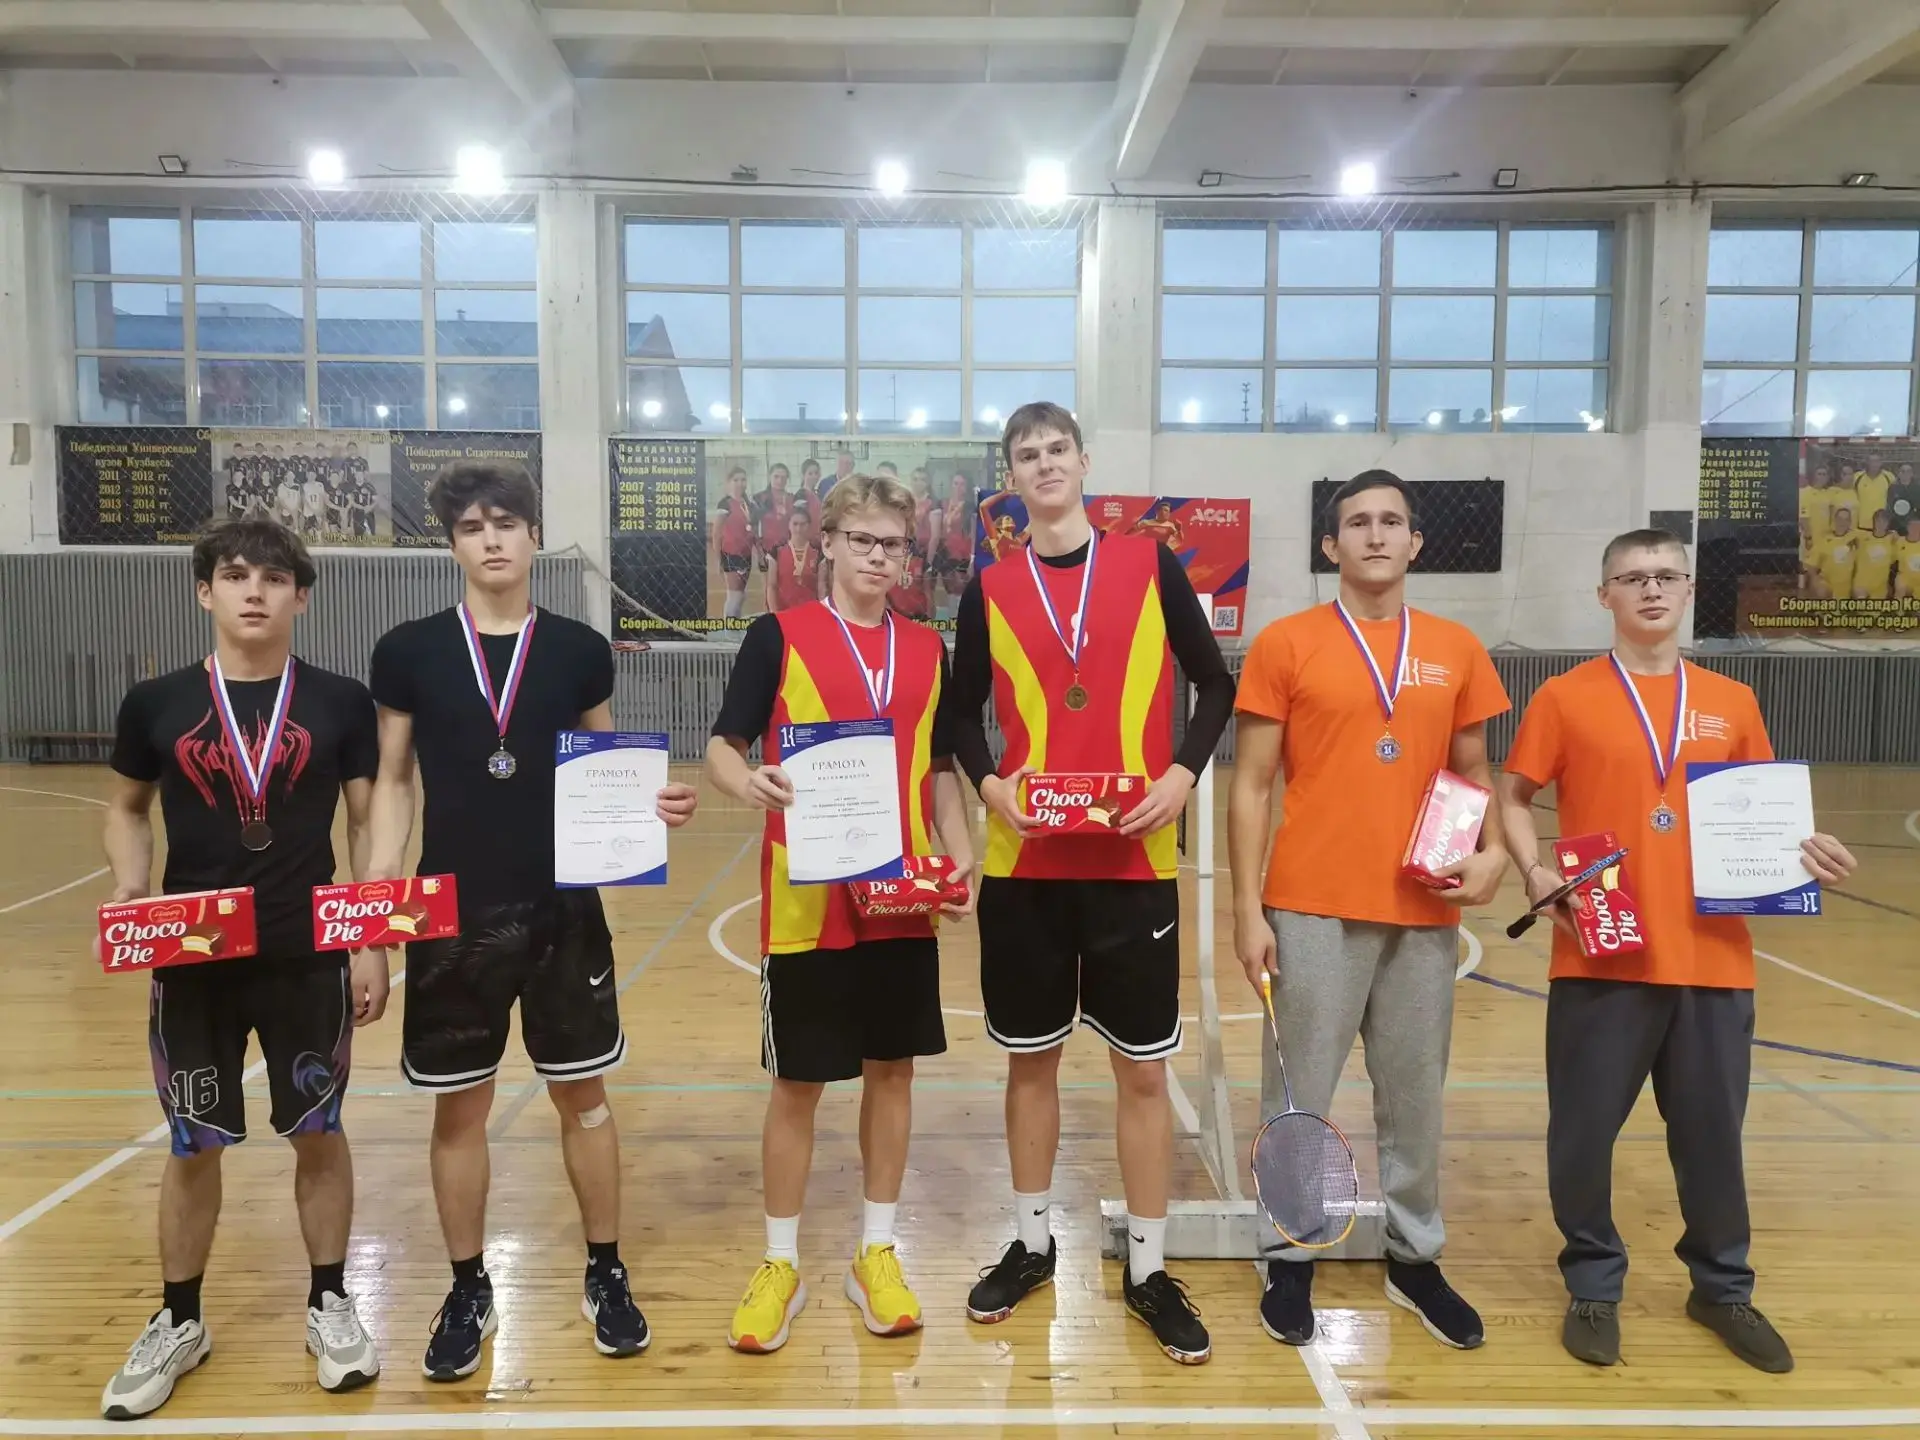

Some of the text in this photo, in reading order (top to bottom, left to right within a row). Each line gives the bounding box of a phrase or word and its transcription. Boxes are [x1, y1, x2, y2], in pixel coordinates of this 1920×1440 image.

[70, 442, 128, 454] Победители
[405, 446, 462, 457] Победители
[620, 482, 645, 492] 2007
[655, 482, 681, 492] 2008
[1699, 480, 1720, 488] 2010
[1729, 480, 1749, 488] 2011
[620, 495, 645, 505] 2008
[655, 495, 681, 505] 2009
[1699, 490, 1719, 499] 2011
[1728, 490, 1750, 499] 2012
[100, 499, 122, 509] 2013
[133, 499, 155, 509] 2014
[1698, 500, 1720, 509] 2012
[1728, 500, 1749, 509] 2013
[100, 513, 122, 523] 2014
[134, 513, 156, 523] 2015
[620, 508, 645, 518] 2009
[655, 508, 681, 518] 2010
[1189, 508, 1240, 523] АССК
[1698, 510, 1720, 519] 2013
[1729, 510, 1751, 519] 2014
[620, 520, 645, 530] 2013
[655, 520, 681, 530] 2014
[1779, 597, 1838, 613] Сборная
[1840, 599, 1900, 612] команда
[620, 617, 669, 631] Сборная
[672, 619, 724, 631] команда
[1749, 613, 1919, 630] Чемпионы Сибири среди
[811, 759, 866, 771] ГРАМОТА
[585, 769, 638, 778] ГРАМОТА
[1031, 788, 1093, 807] Choco
[1035, 808, 1067, 827] Pie
[1425, 818, 1454, 872] Choco
[1726, 868, 1785, 877] ГРАМОТА
[323, 887, 349, 895] LOTTE
[868, 880, 900, 896] Pie
[110, 908, 139, 917] LOTTE
[318, 899, 394, 922] Choco
[866, 904, 908, 916] Choco
[908, 901, 933, 914] Pie
[1590, 887, 1620, 950] Choco
[105, 920, 187, 944] Choco
[319, 921, 363, 945] Pie
[1616, 910, 1644, 945] Pie
[1584, 926, 1595, 948] LOTTE
[108, 943, 155, 968] Pie
[172, 1065, 220, 1117] 16
